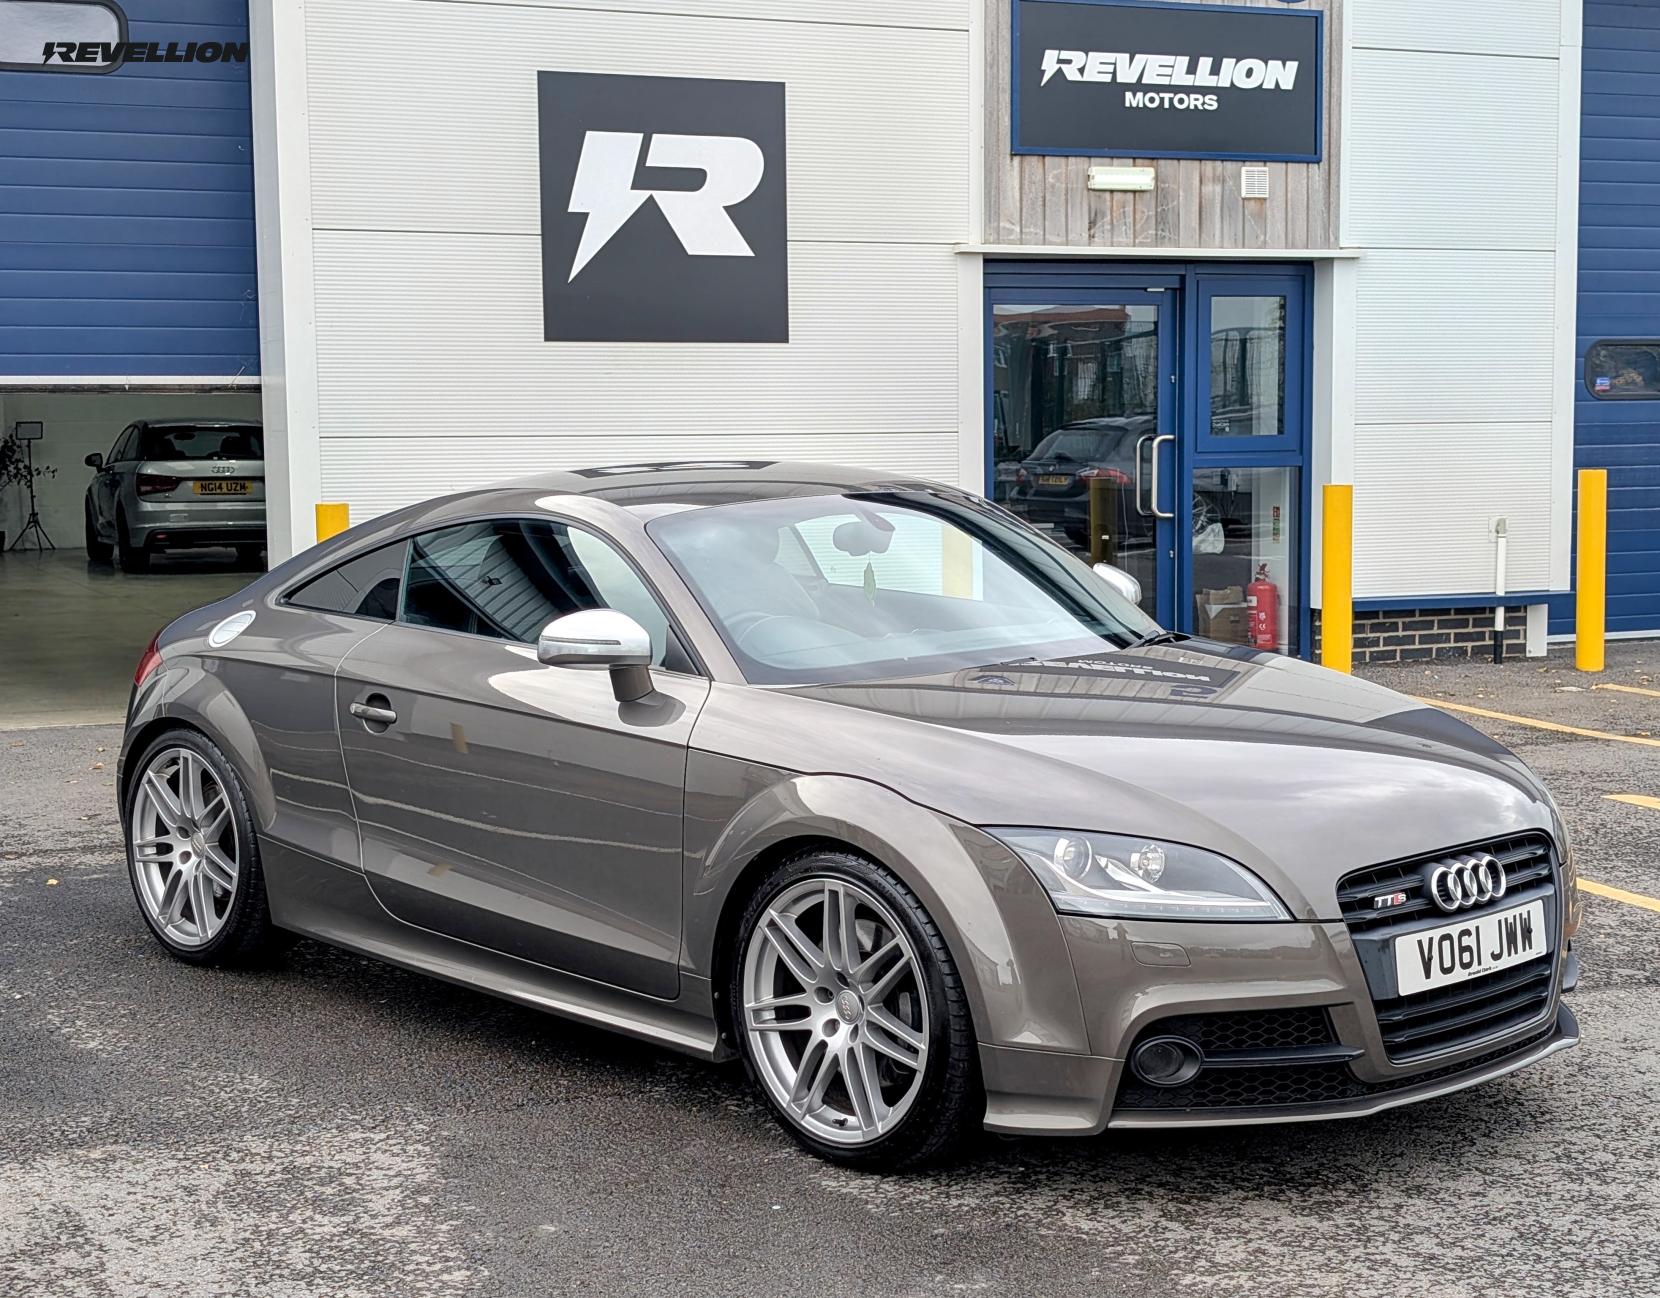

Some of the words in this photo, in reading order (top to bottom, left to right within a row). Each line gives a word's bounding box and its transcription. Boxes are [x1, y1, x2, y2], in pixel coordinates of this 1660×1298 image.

[1040, 49, 1299, 90] REVELLION
[1125, 91, 1218, 111] MOTORS
[200, 482, 223, 492] NG14
[226, 482, 247, 492] UZM
[1374, 892, 1407, 909] TTS
[1417, 925, 1482, 980] VO61
[1490, 910, 1534, 962] JWW
